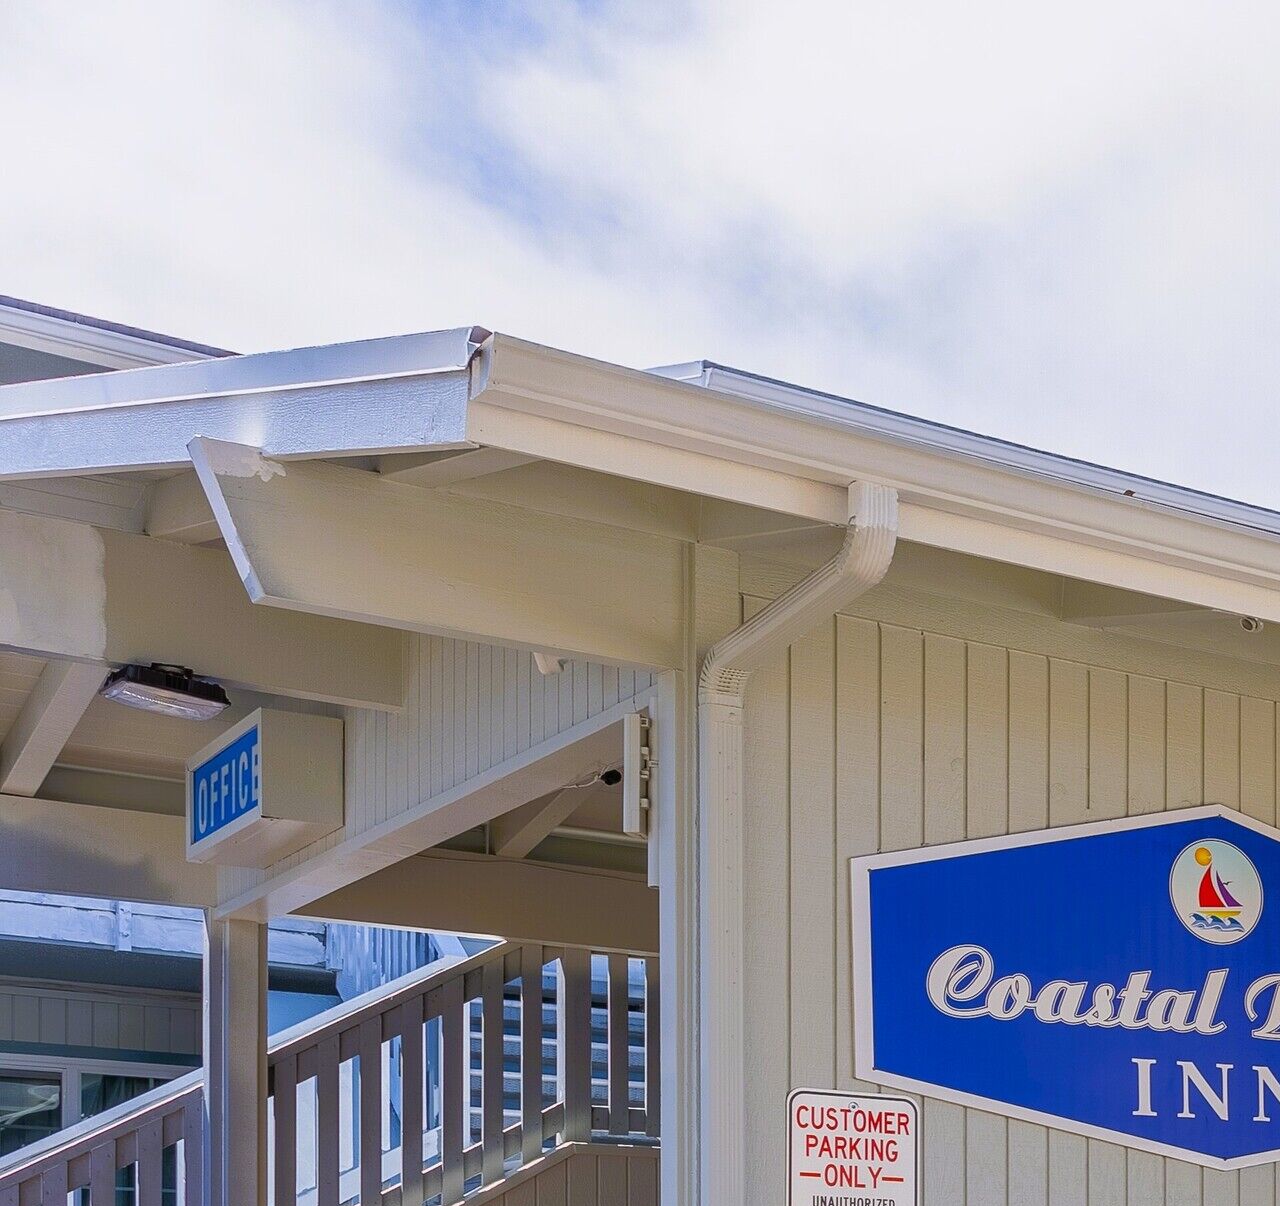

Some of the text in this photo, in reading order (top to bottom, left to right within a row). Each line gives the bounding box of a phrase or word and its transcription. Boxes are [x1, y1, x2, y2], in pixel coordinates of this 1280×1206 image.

[199, 744, 259, 834] OFFICE
[927, 944, 1229, 1035] Coastal
[796, 1105, 910, 1135] CUSTOMER
[805, 1135, 899, 1162] PARKING
[824, 1163, 883, 1189] ONLY
